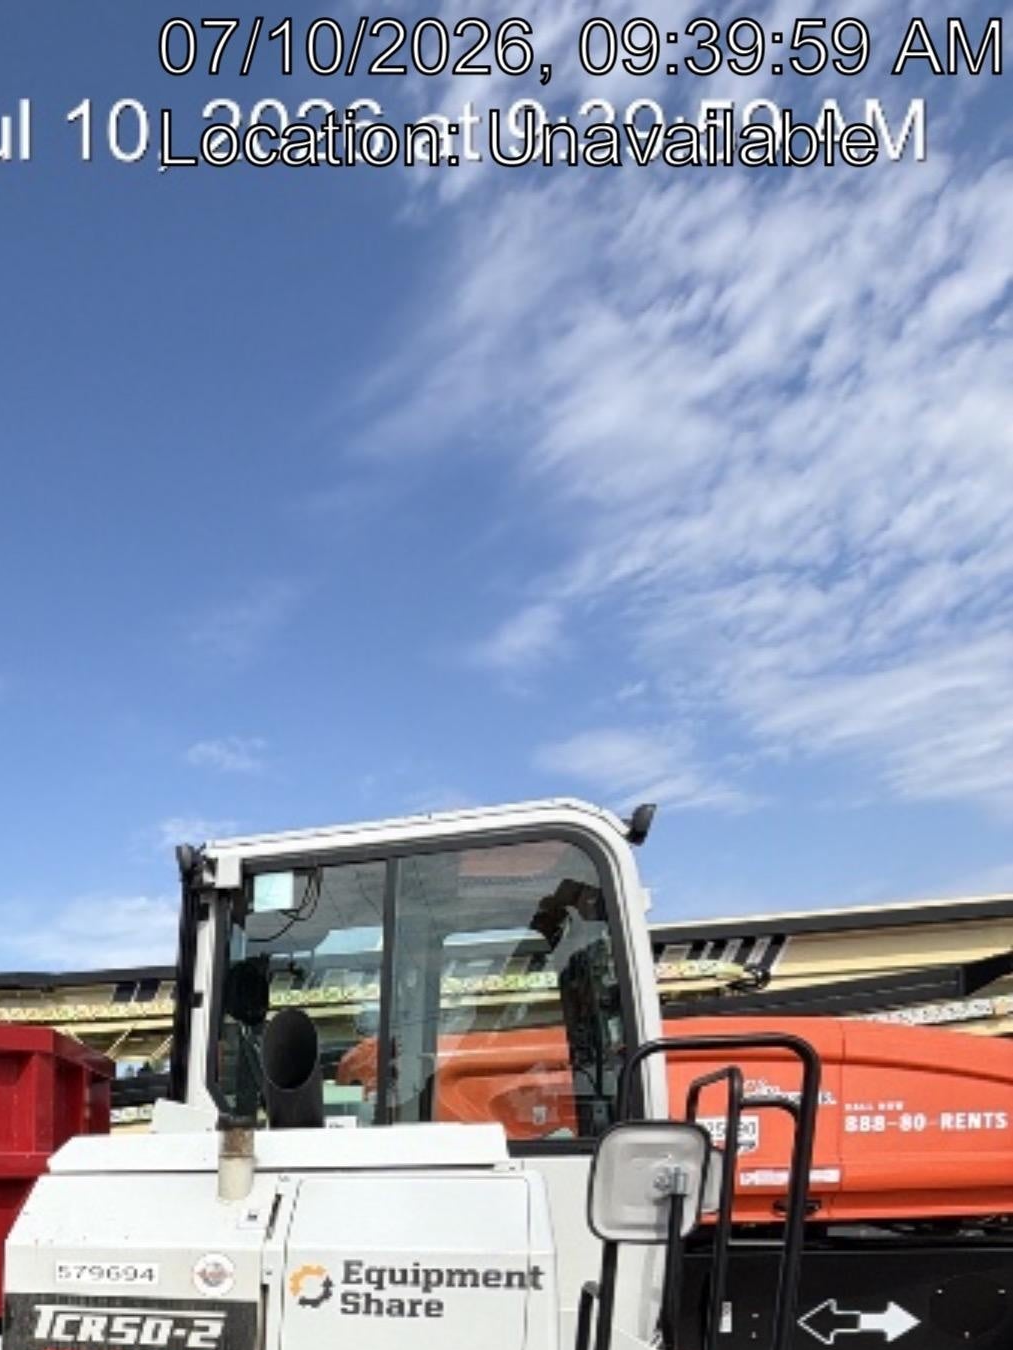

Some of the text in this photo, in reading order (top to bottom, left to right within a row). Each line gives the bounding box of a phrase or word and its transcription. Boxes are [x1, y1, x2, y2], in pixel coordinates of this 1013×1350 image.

[58, 1264, 154, 1281] 579694
[341, 1259, 545, 1293] Equipment
[340, 1291, 445, 1317] Share
